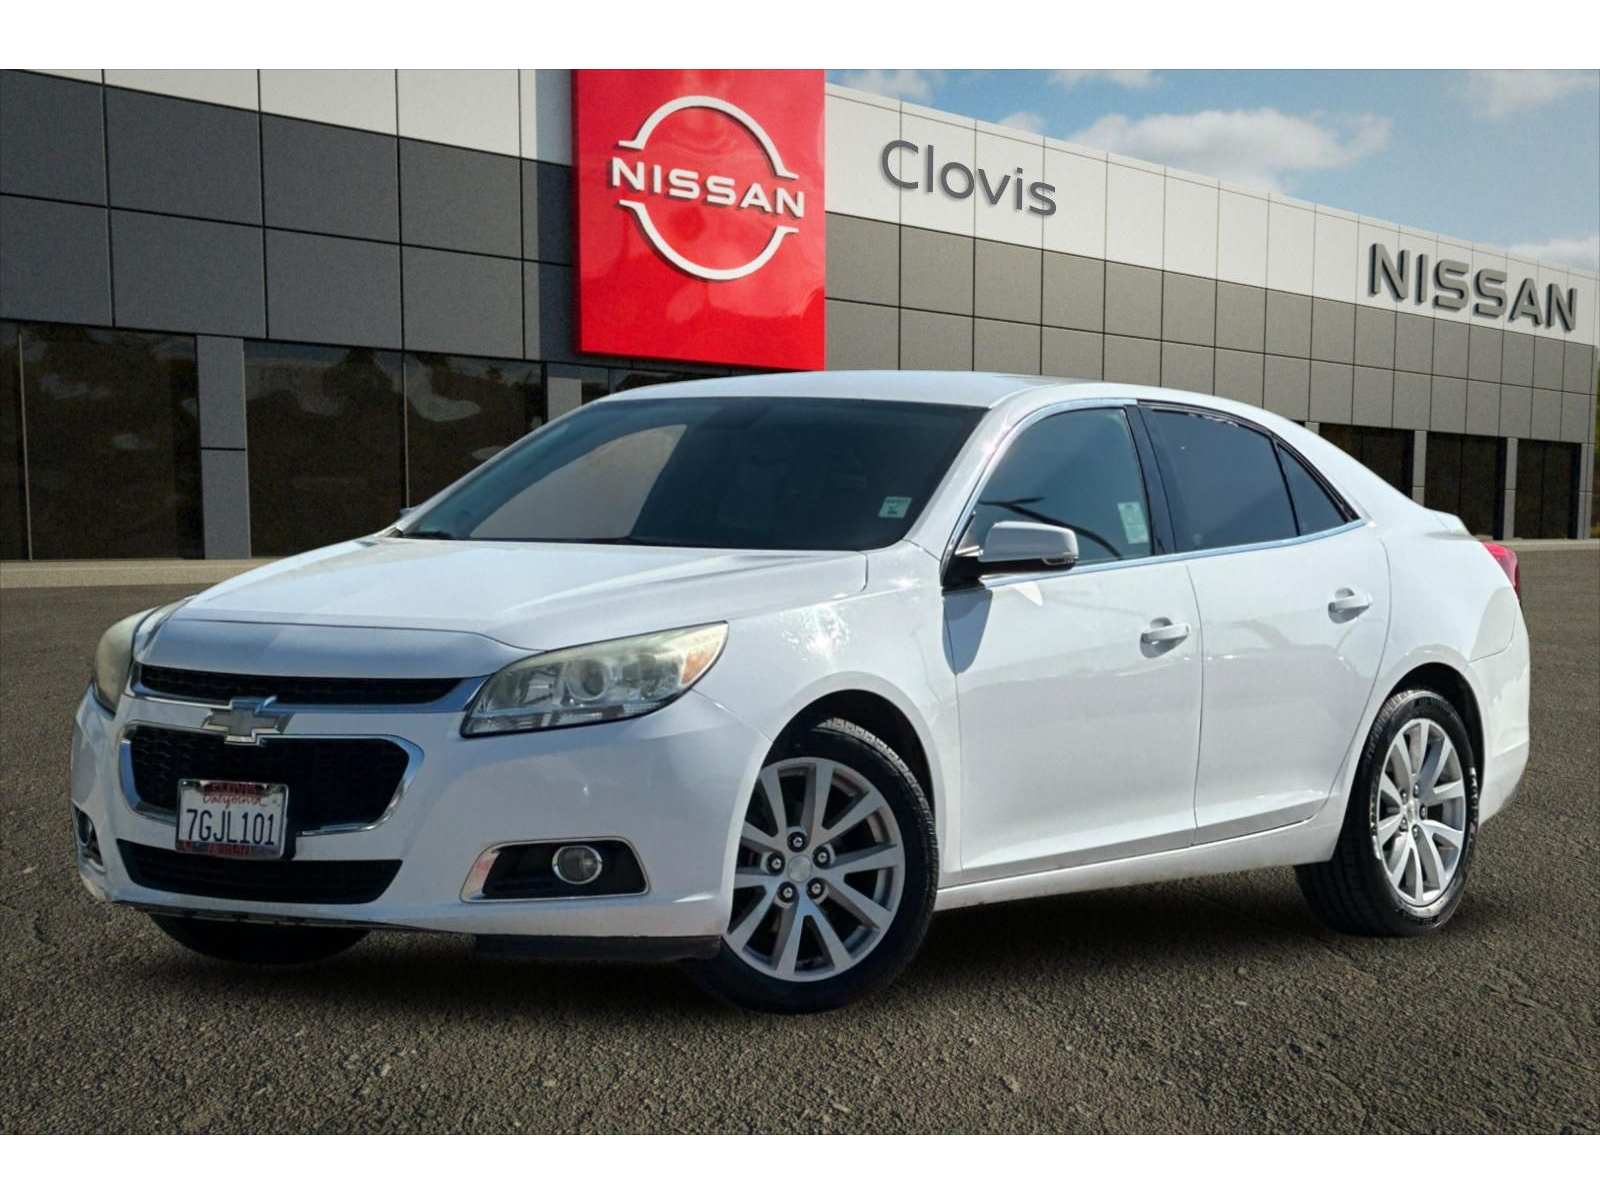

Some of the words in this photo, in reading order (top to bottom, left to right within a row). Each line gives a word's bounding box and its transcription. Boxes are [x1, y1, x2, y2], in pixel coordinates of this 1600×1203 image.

[611, 156, 805, 218] NISSAN
[881, 139, 1057, 216] Clovis
[1368, 243, 1578, 332] NISSAN
[186, 808, 275, 846] 7GJL101
